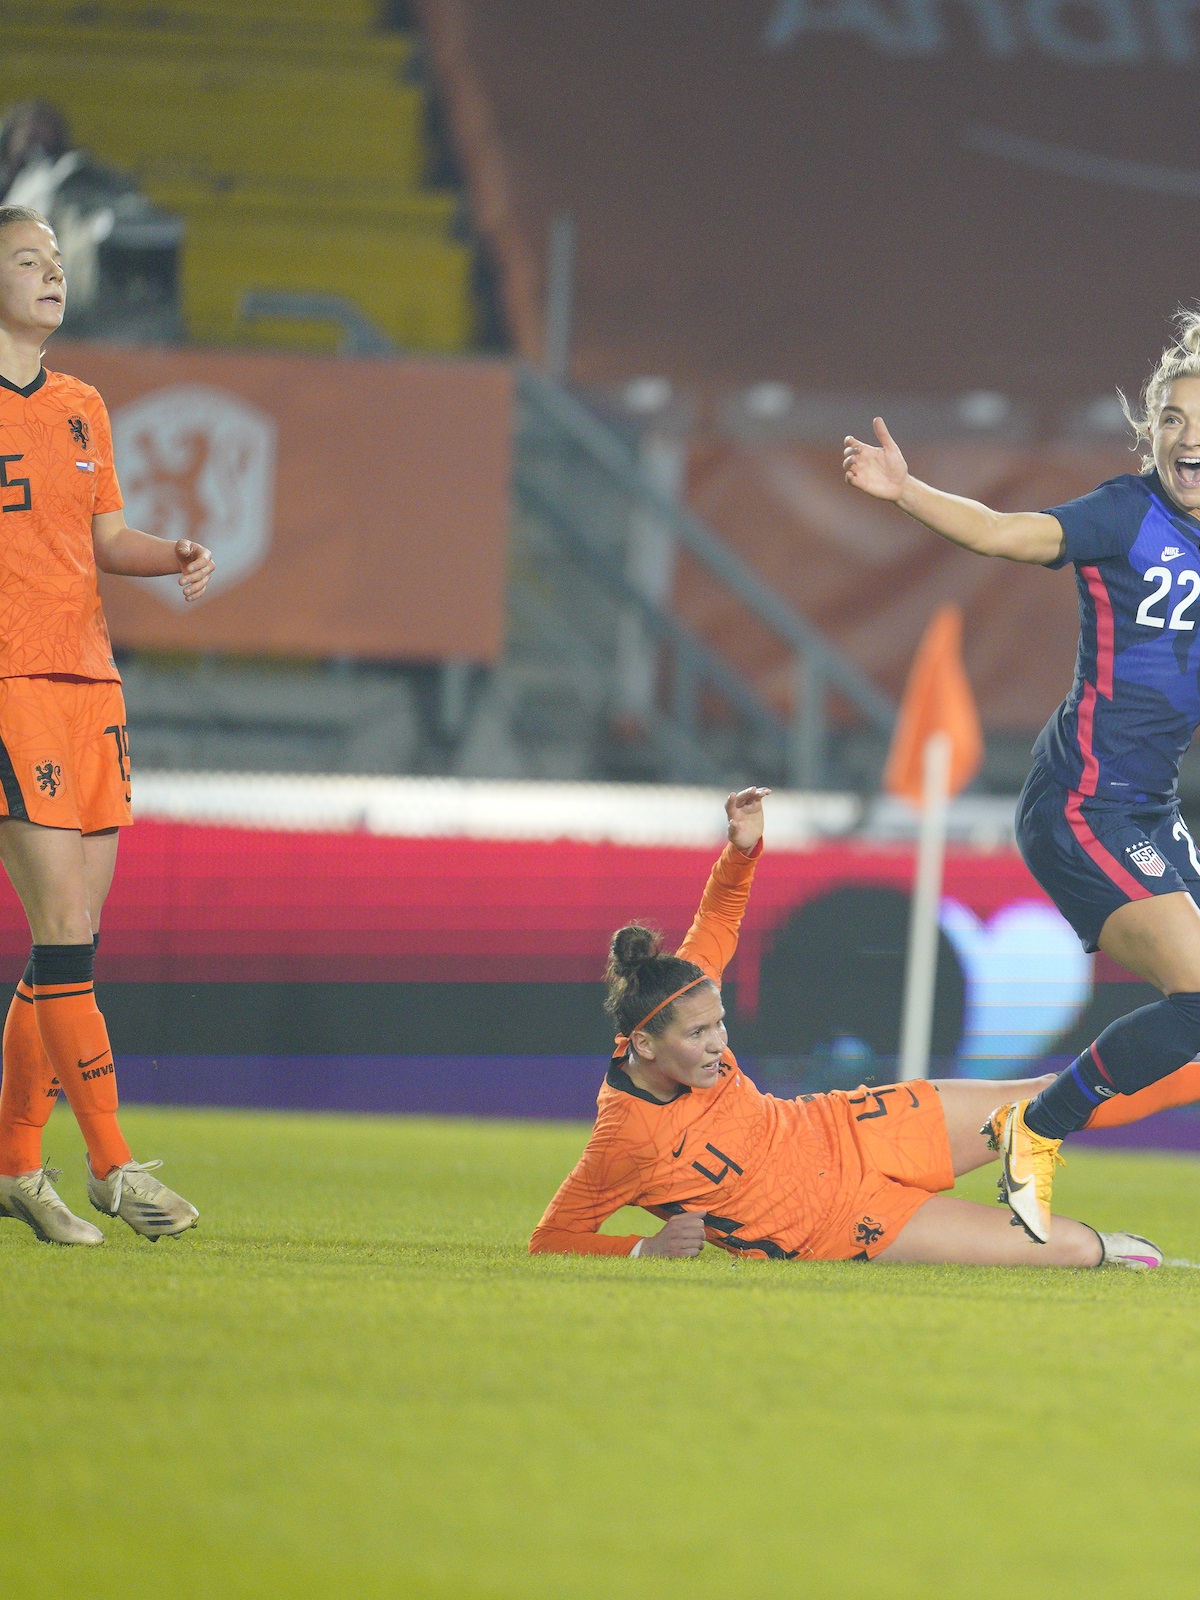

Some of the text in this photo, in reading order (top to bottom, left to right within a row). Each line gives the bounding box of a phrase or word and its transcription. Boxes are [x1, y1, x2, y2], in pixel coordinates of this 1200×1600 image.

[1164, 546, 1180, 556] NIKE
[1132, 847, 1155, 862] USA
[82, 1063, 113, 1081] KNVB
[692, 1143, 743, 1185] 4
